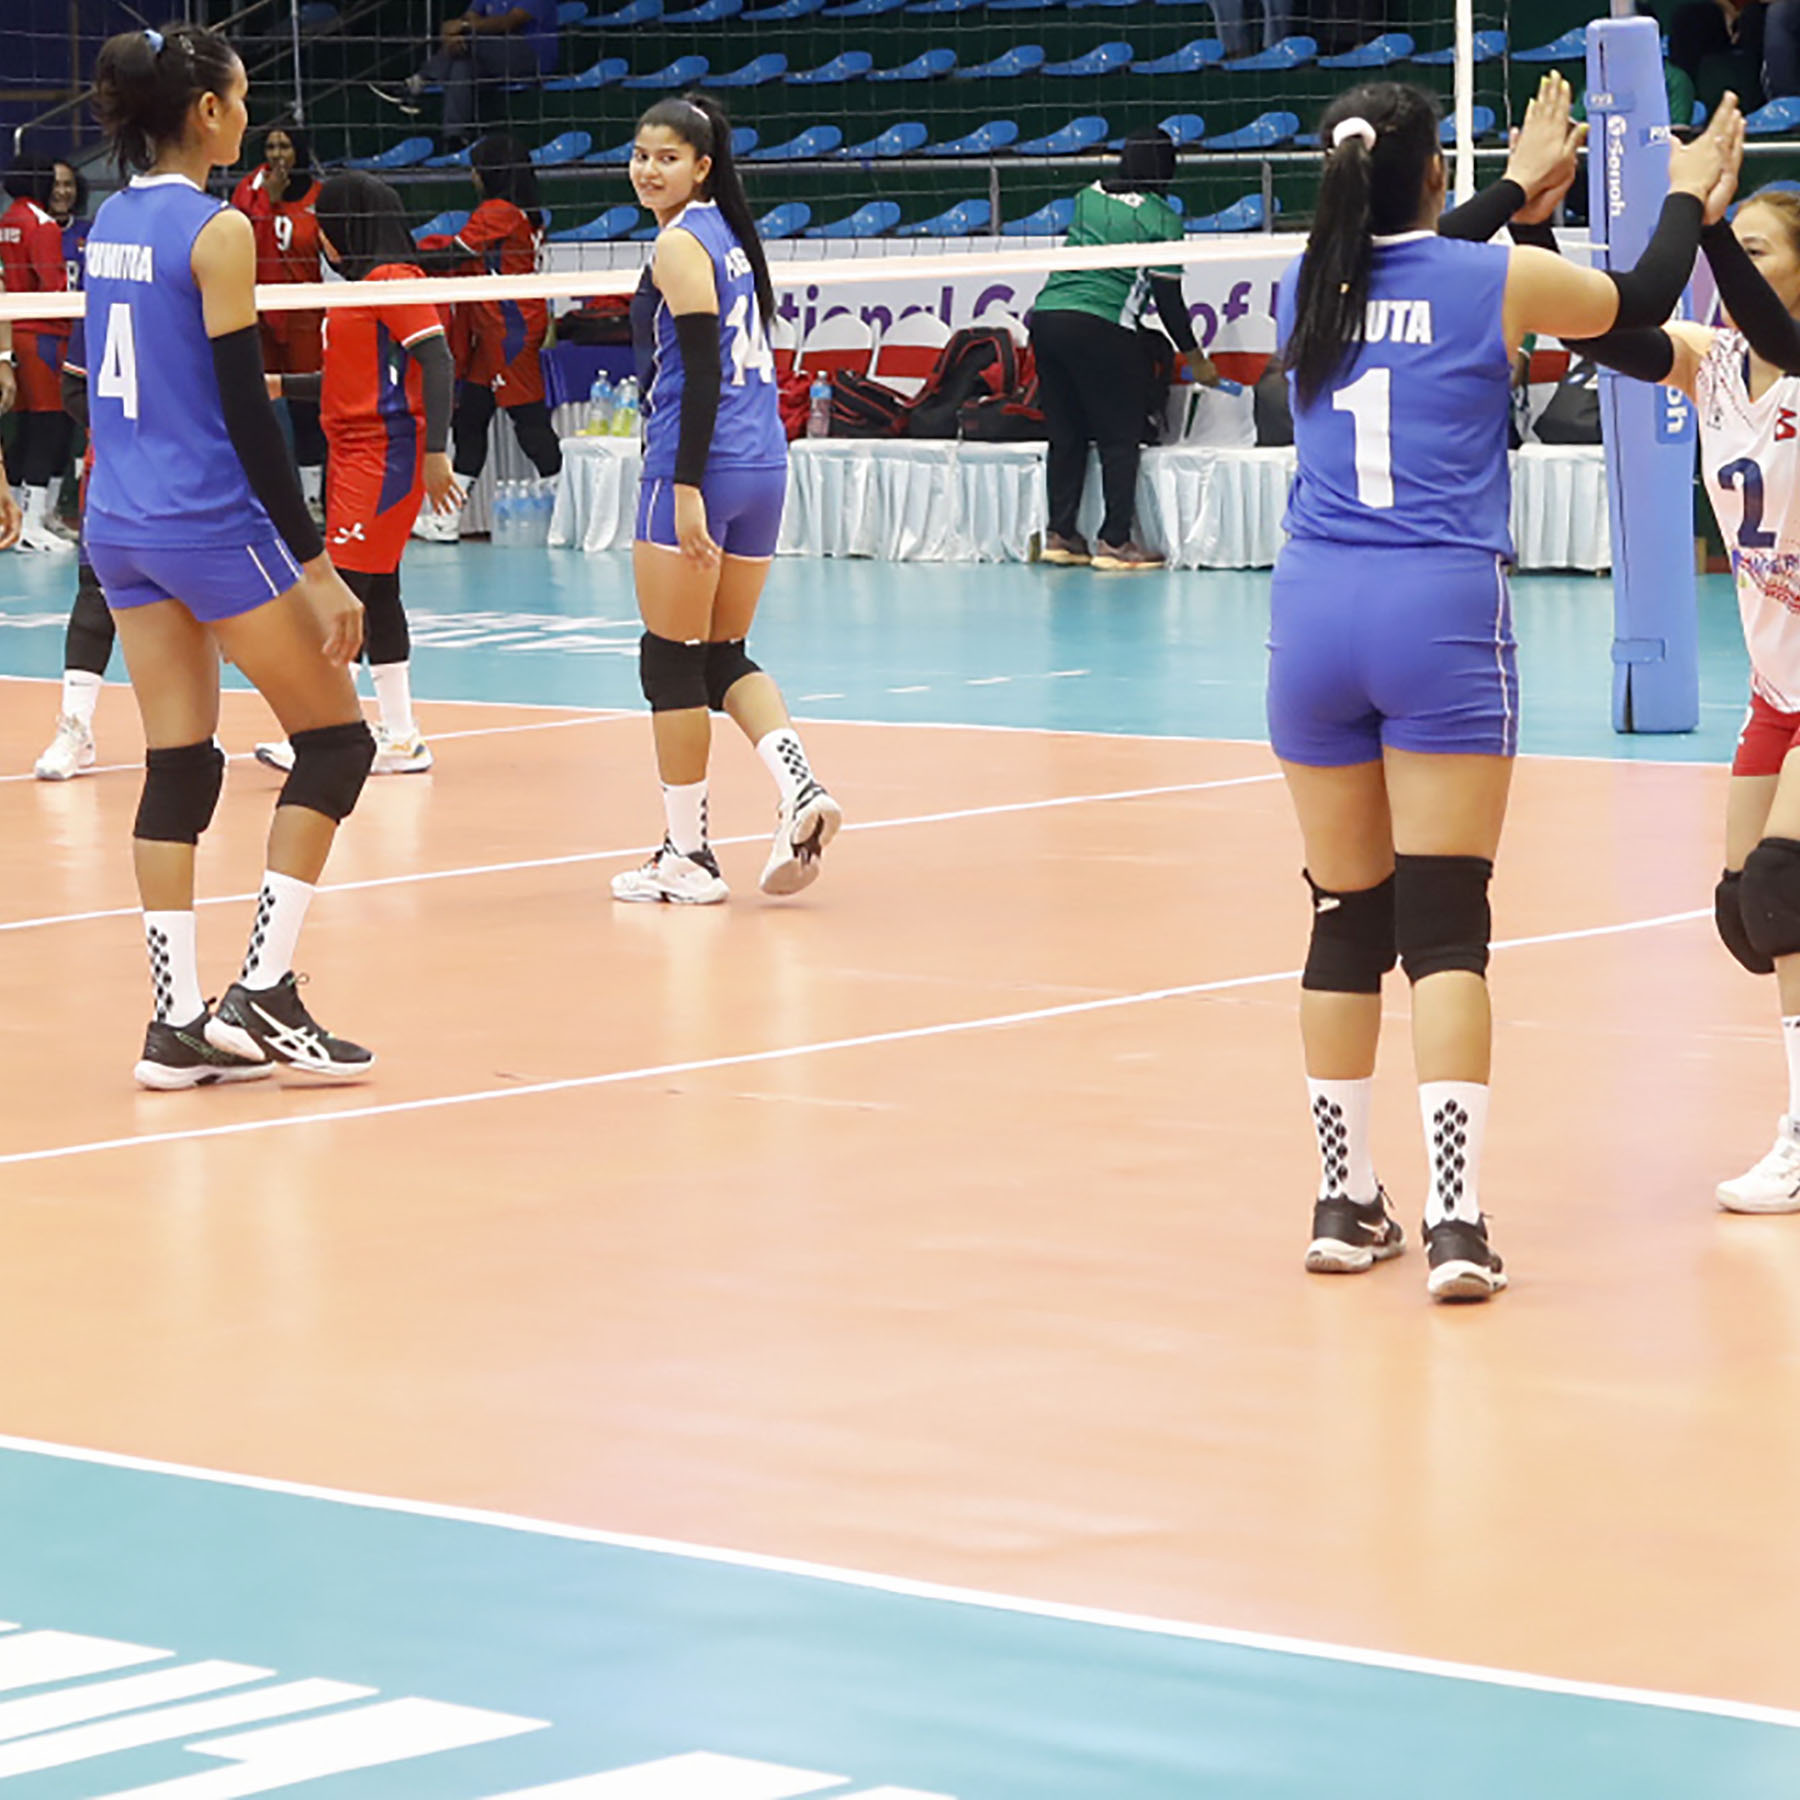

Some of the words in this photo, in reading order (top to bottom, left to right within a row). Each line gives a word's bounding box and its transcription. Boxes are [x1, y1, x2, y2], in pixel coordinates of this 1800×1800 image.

[274, 215, 293, 251] 9
[98, 302, 138, 420] 4
[1333, 367, 1394, 509] 1
[1718, 457, 1777, 549] 2
